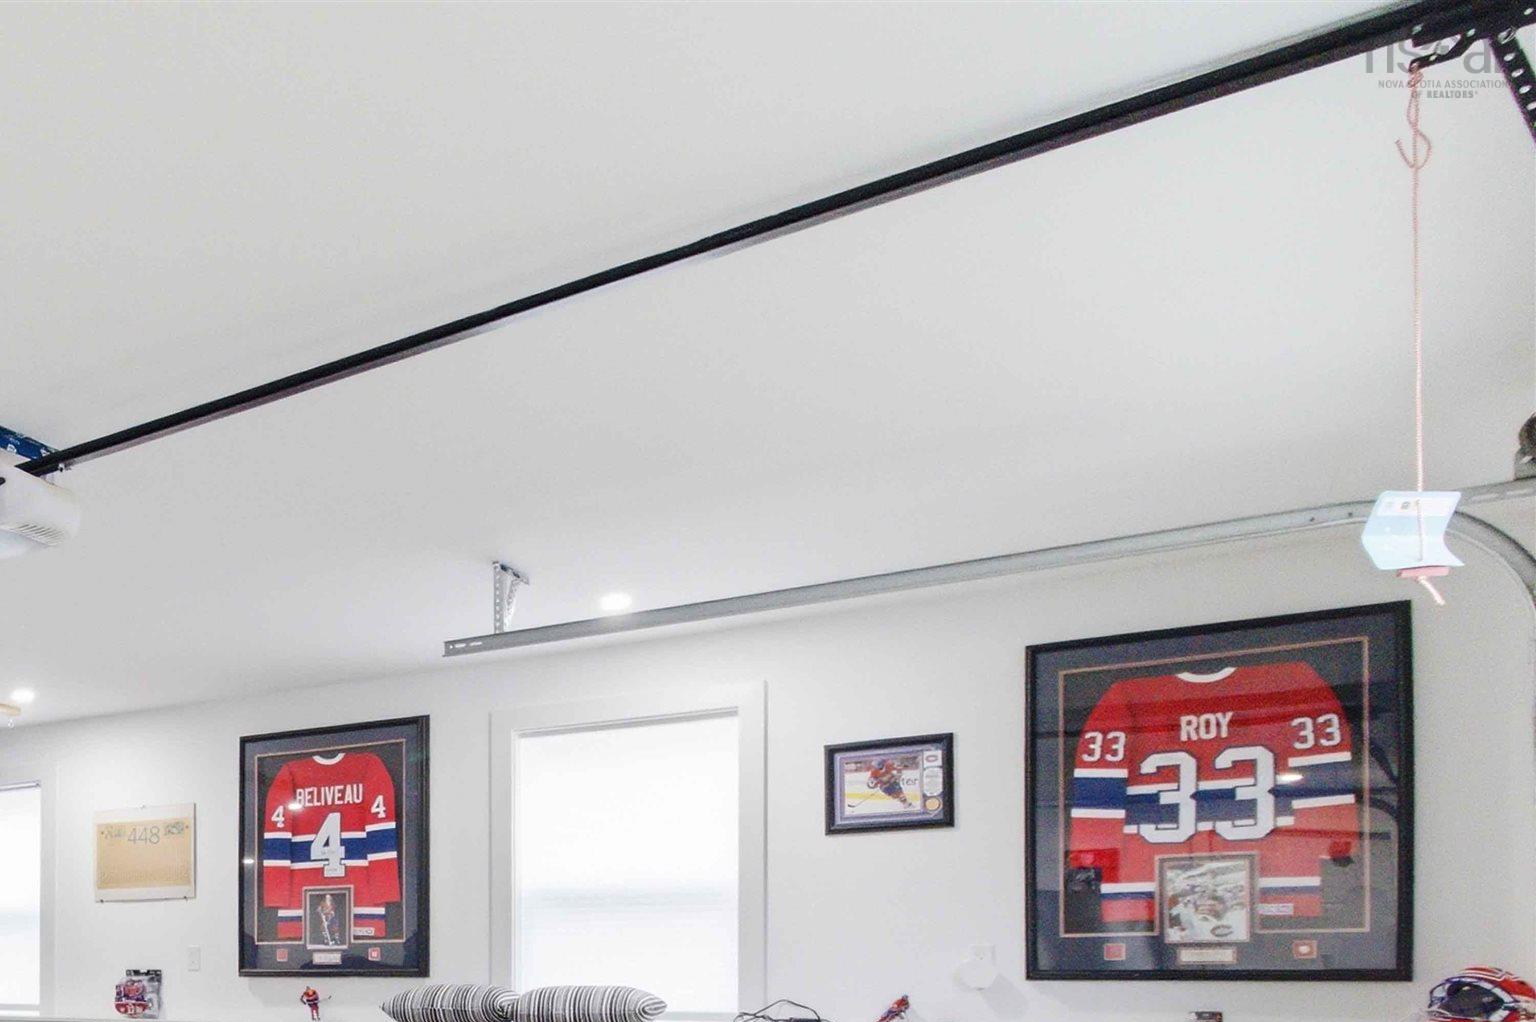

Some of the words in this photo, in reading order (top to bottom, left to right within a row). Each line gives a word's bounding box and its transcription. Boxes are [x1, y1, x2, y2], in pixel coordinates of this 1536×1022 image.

[1179, 711, 1235, 742] ROY
[1290, 713, 1342, 750] 33
[1081, 731, 1127, 763] 33
[296, 783, 364, 808] BELIVEAU
[370, 794, 387, 819] 4
[1138, 746, 1277, 843] 33
[271, 805, 285, 828] 4
[128, 825, 161, 845] 448
[310, 812, 346, 878] 4
